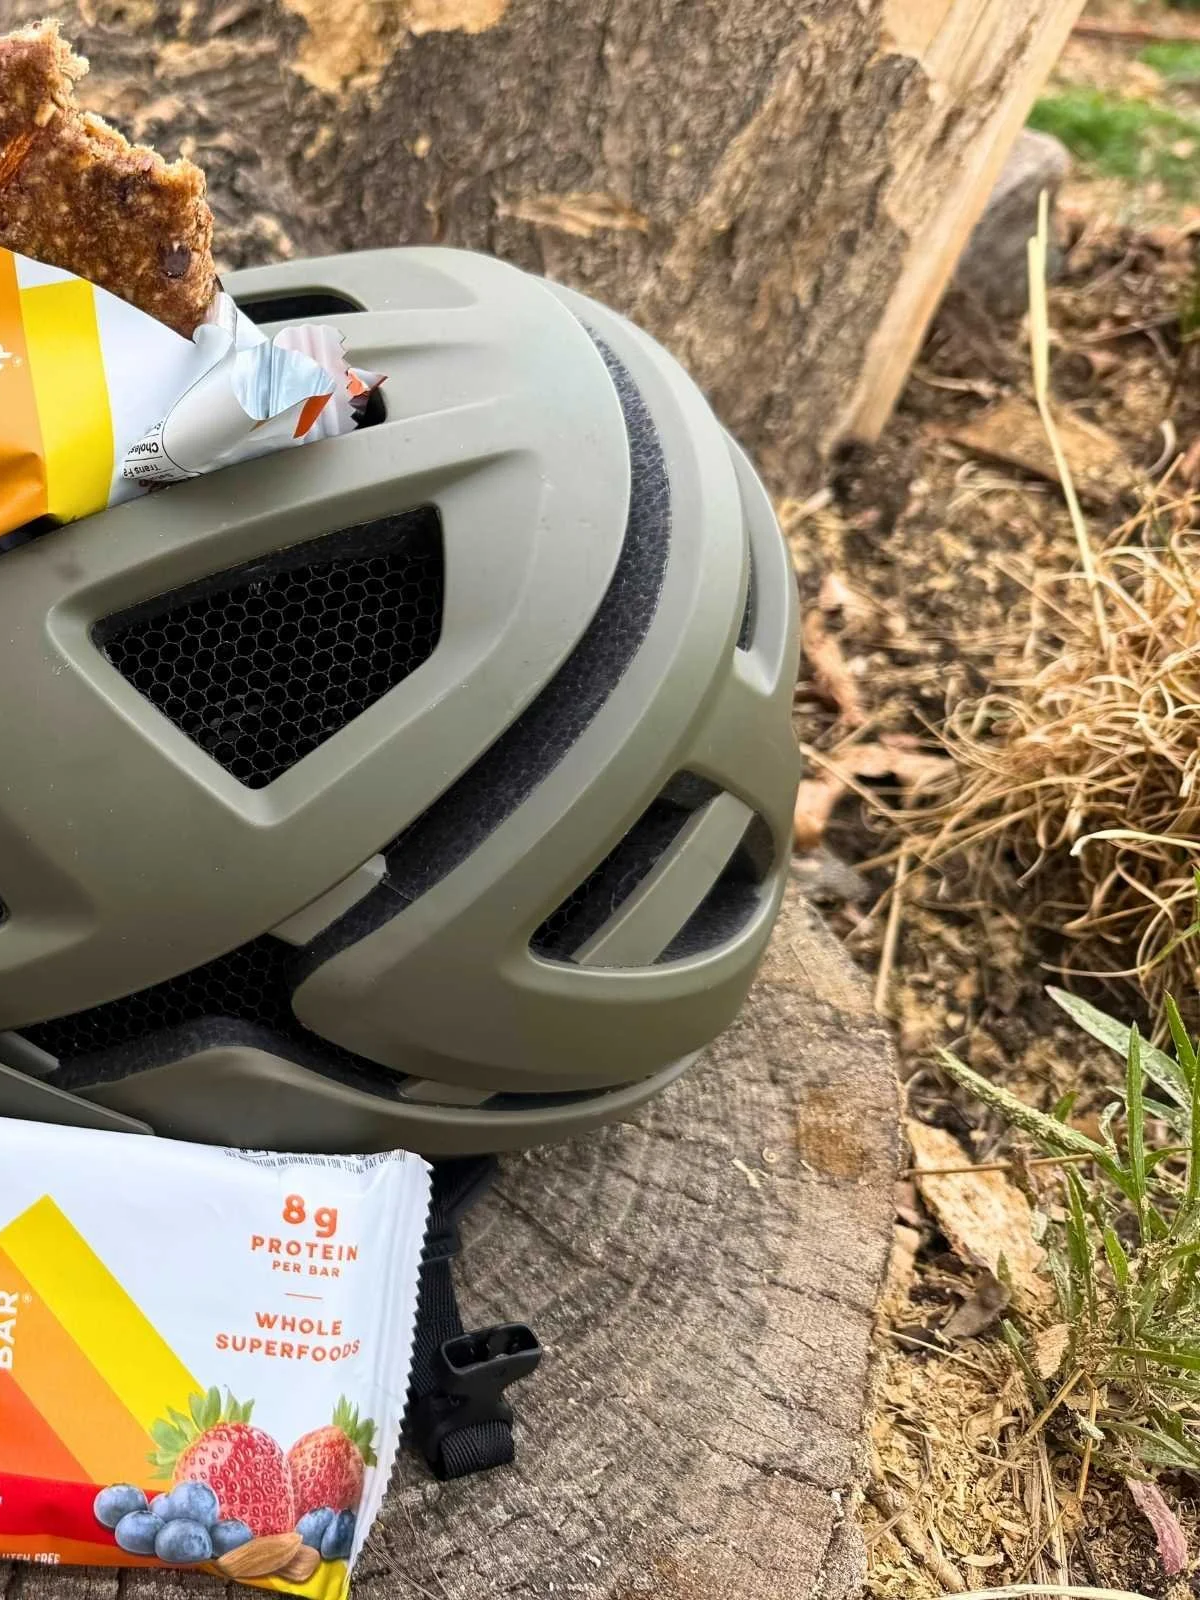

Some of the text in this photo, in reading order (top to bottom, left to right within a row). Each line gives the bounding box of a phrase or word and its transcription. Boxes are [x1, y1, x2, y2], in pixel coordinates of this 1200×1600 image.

[278, 1157, 326, 1168] INFORMATION
[328, 1158, 341, 1169] FOR
[282, 1194, 338, 1238] 8g
[251, 1235, 359, 1261] PROTEIN
[272, 1260, 340, 1277] PER BAR
[256, 1311, 342, 1336] WHOLE
[216, 1334, 360, 1362] SUPERFOODS
